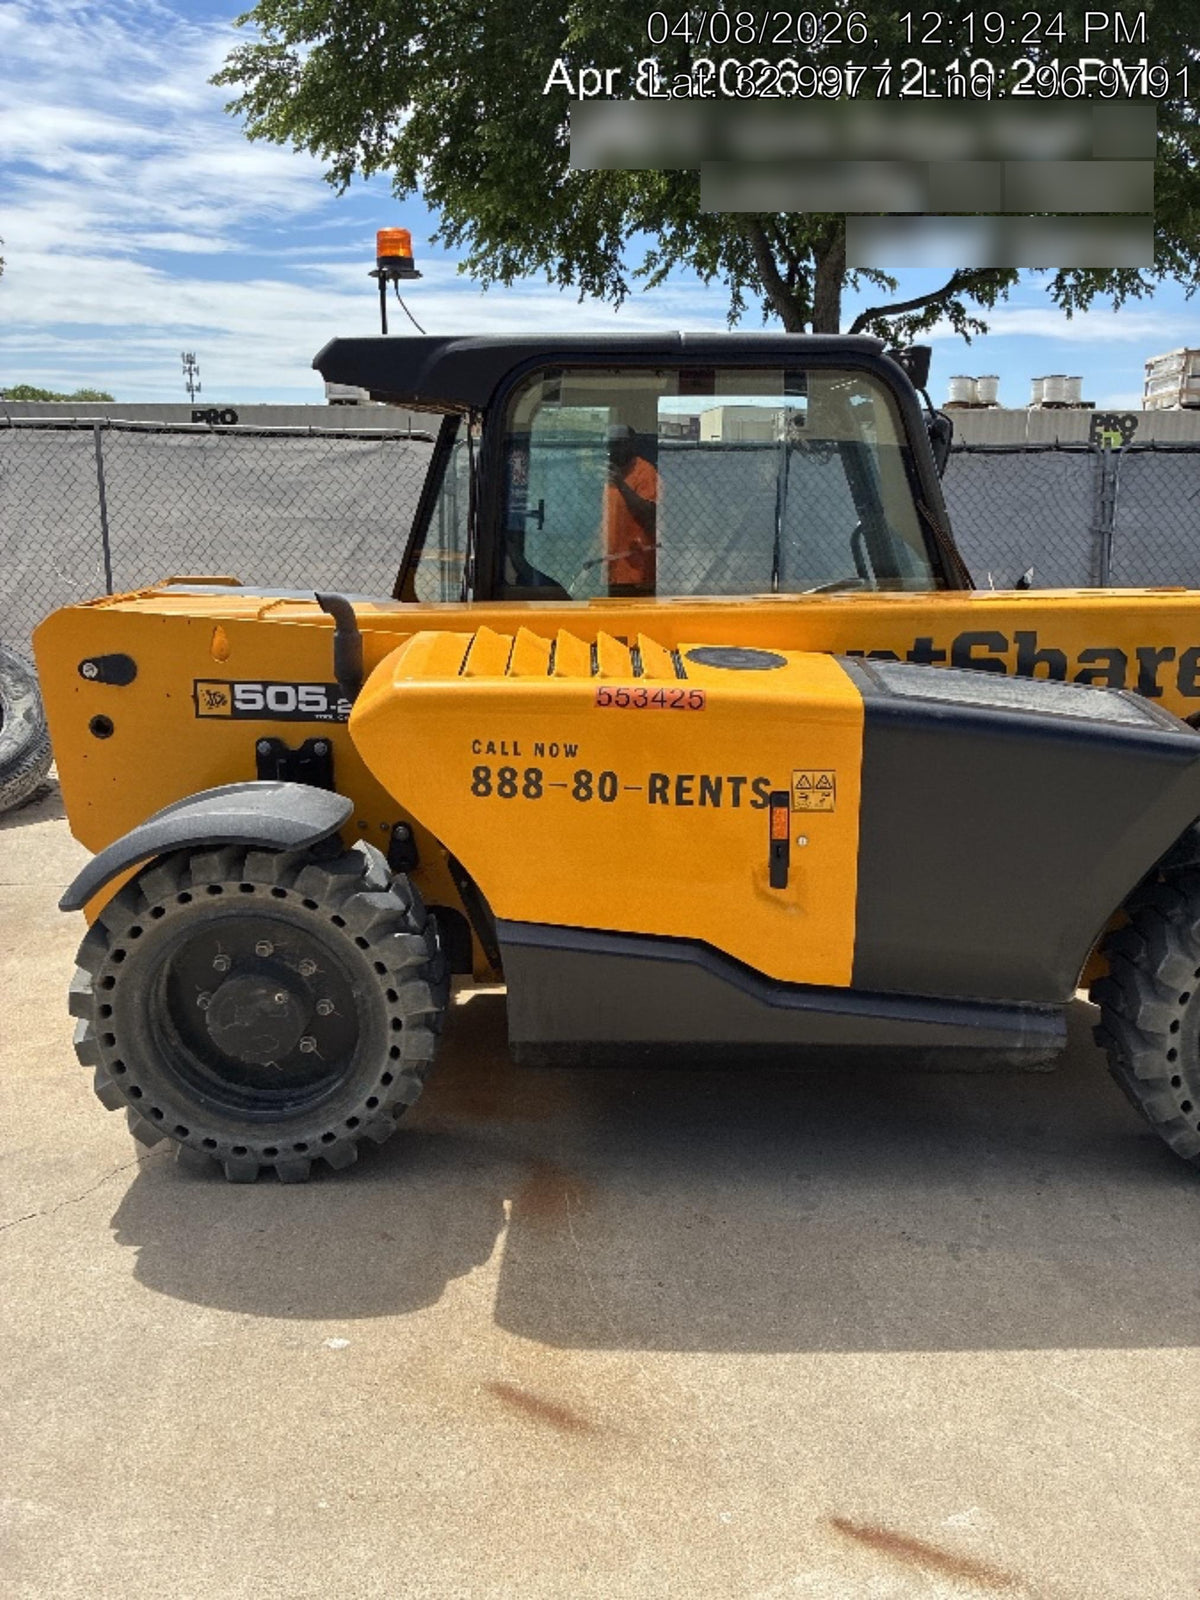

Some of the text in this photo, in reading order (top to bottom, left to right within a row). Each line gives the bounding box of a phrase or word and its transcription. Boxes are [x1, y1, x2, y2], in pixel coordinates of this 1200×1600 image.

[596, 687, 704, 709] 553425
[471, 739, 579, 758] CALL NOW
[470, 765, 771, 809] 888-80-RENTS
